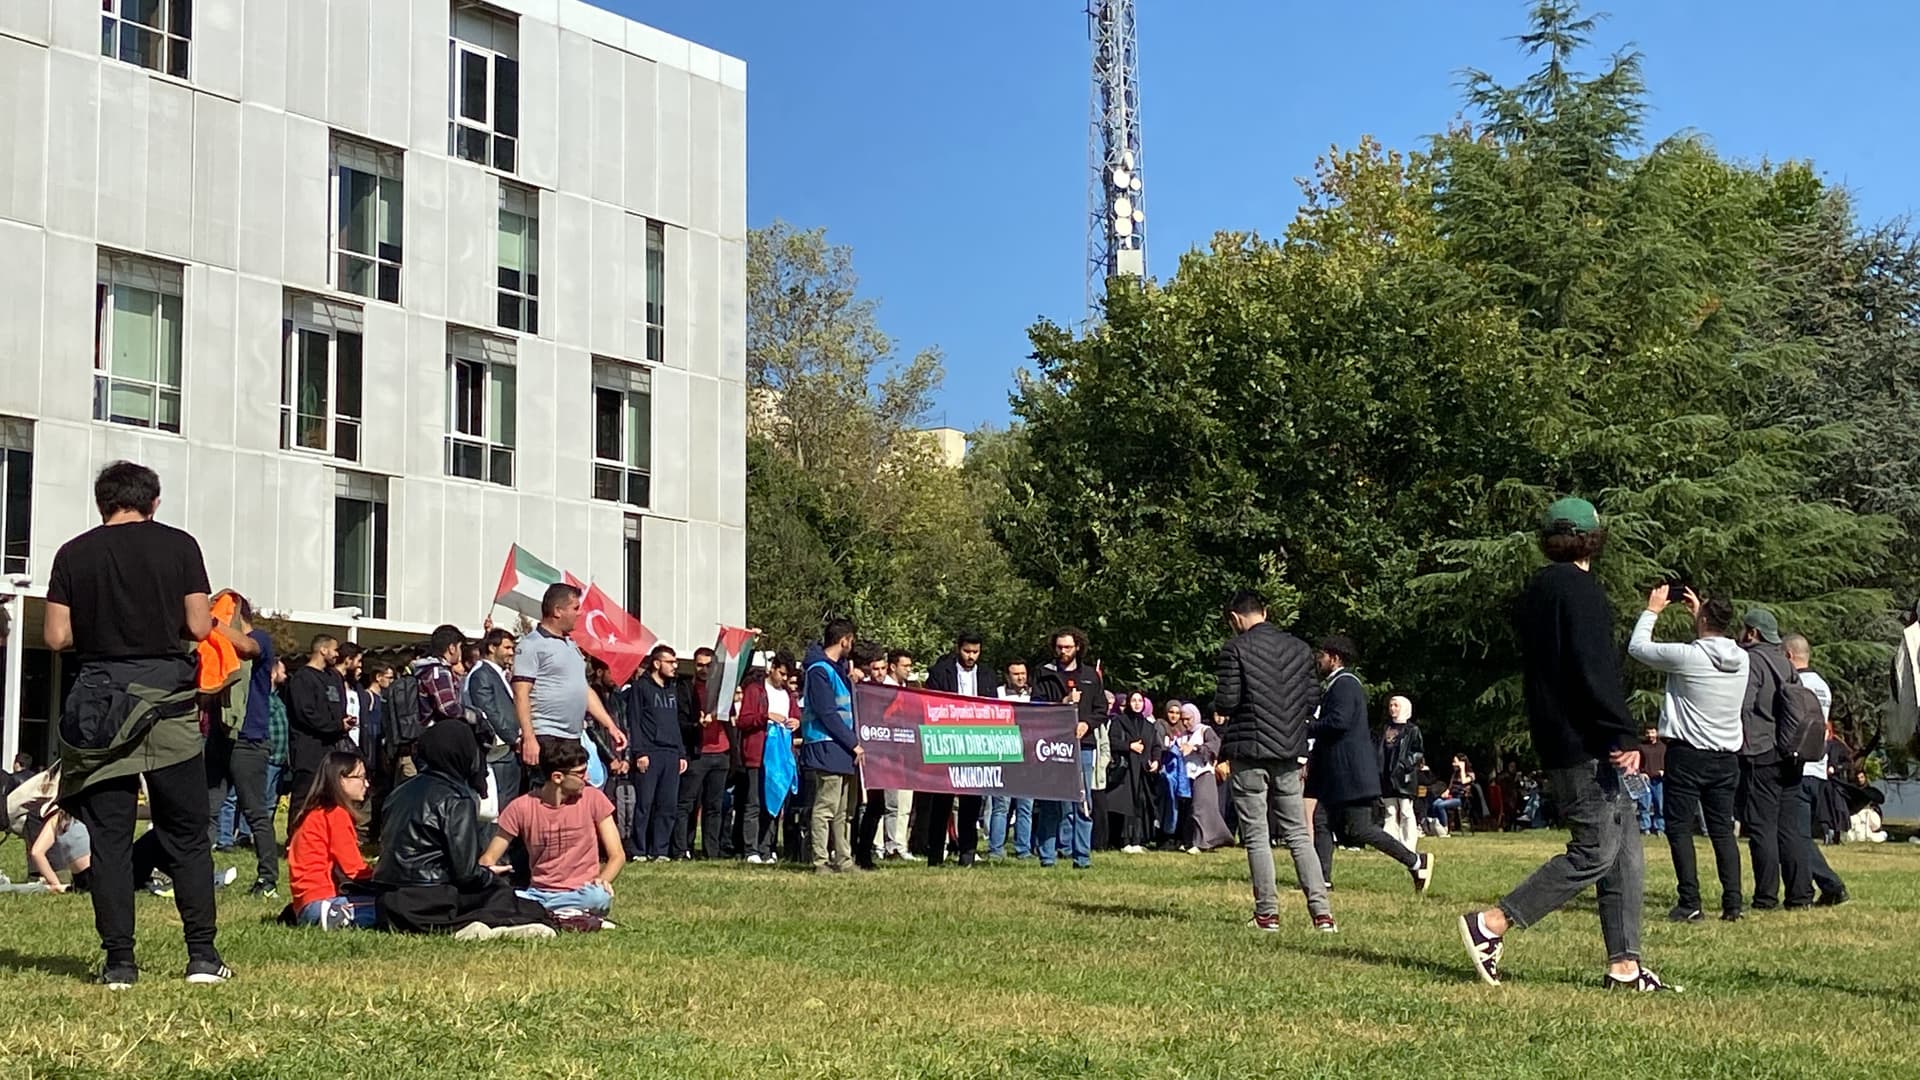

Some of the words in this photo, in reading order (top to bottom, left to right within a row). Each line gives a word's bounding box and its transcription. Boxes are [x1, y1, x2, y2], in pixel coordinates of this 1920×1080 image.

[870, 726, 890, 738] AGD
[924, 729, 965, 755] FİLİSTİN
[965, 729, 1021, 760] DİRENİŞİNİN
[1050, 741, 1074, 757] MGV
[948, 766, 1004, 788] YANINDAYIZ
